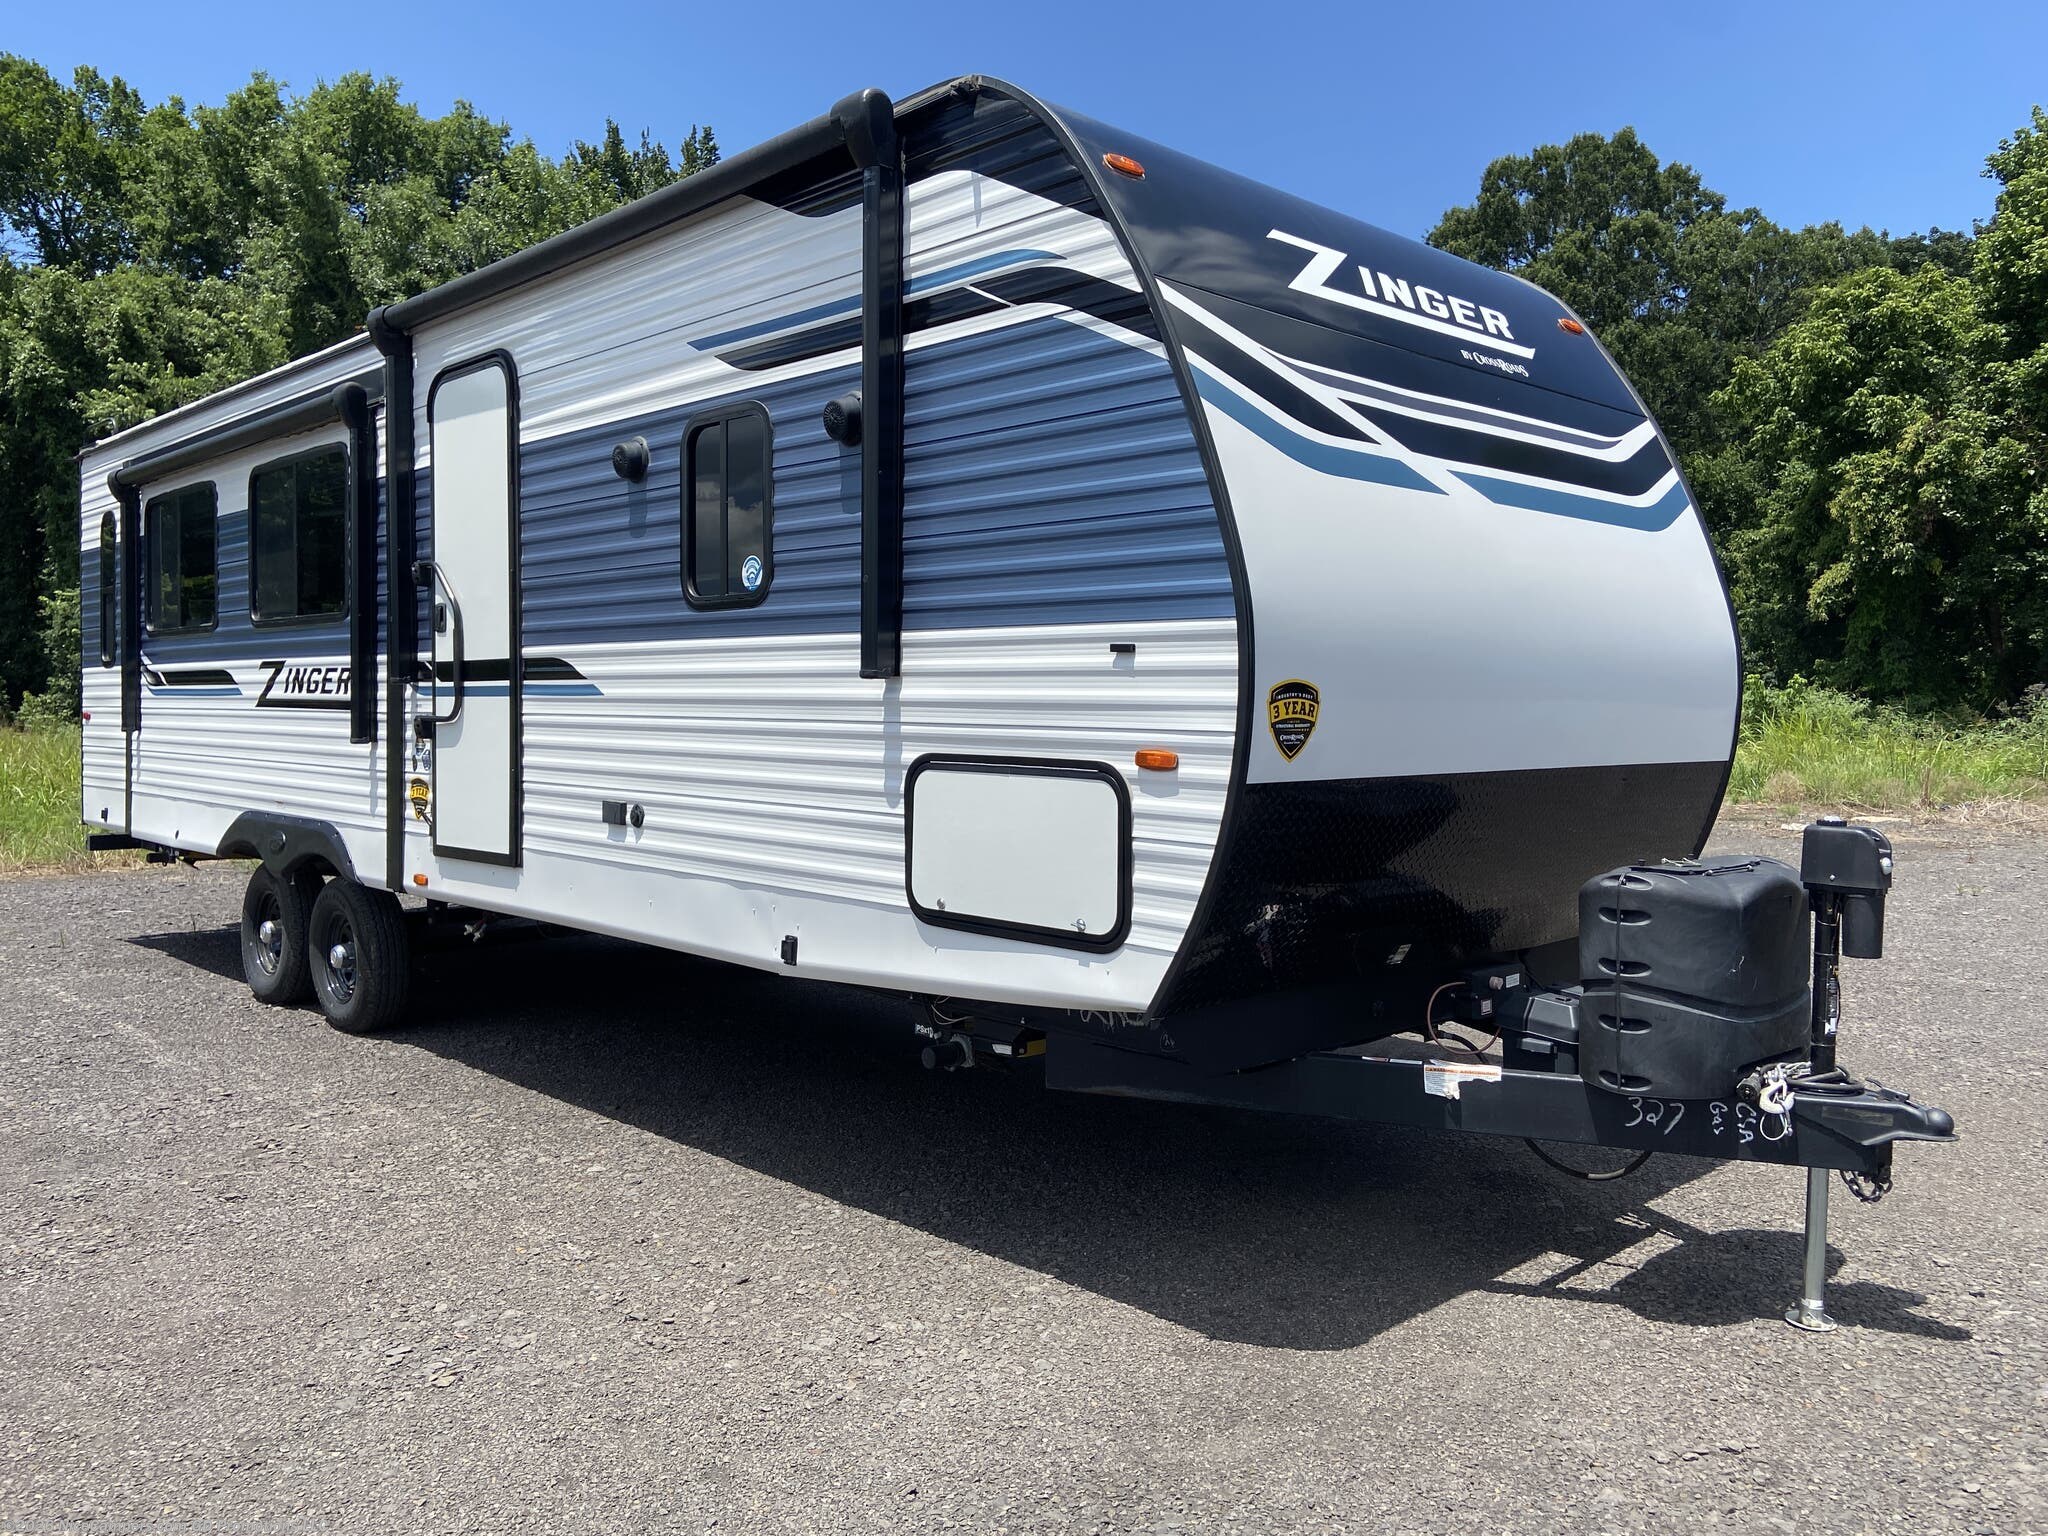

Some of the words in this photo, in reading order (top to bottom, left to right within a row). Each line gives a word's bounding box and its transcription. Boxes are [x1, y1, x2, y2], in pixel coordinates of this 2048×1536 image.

[1266, 228, 1536, 360] ZINGER
[1273, 704, 1280, 720] 3
[1284, 701, 1315, 718] YEAR
[1624, 1096, 1686, 1136] 327
